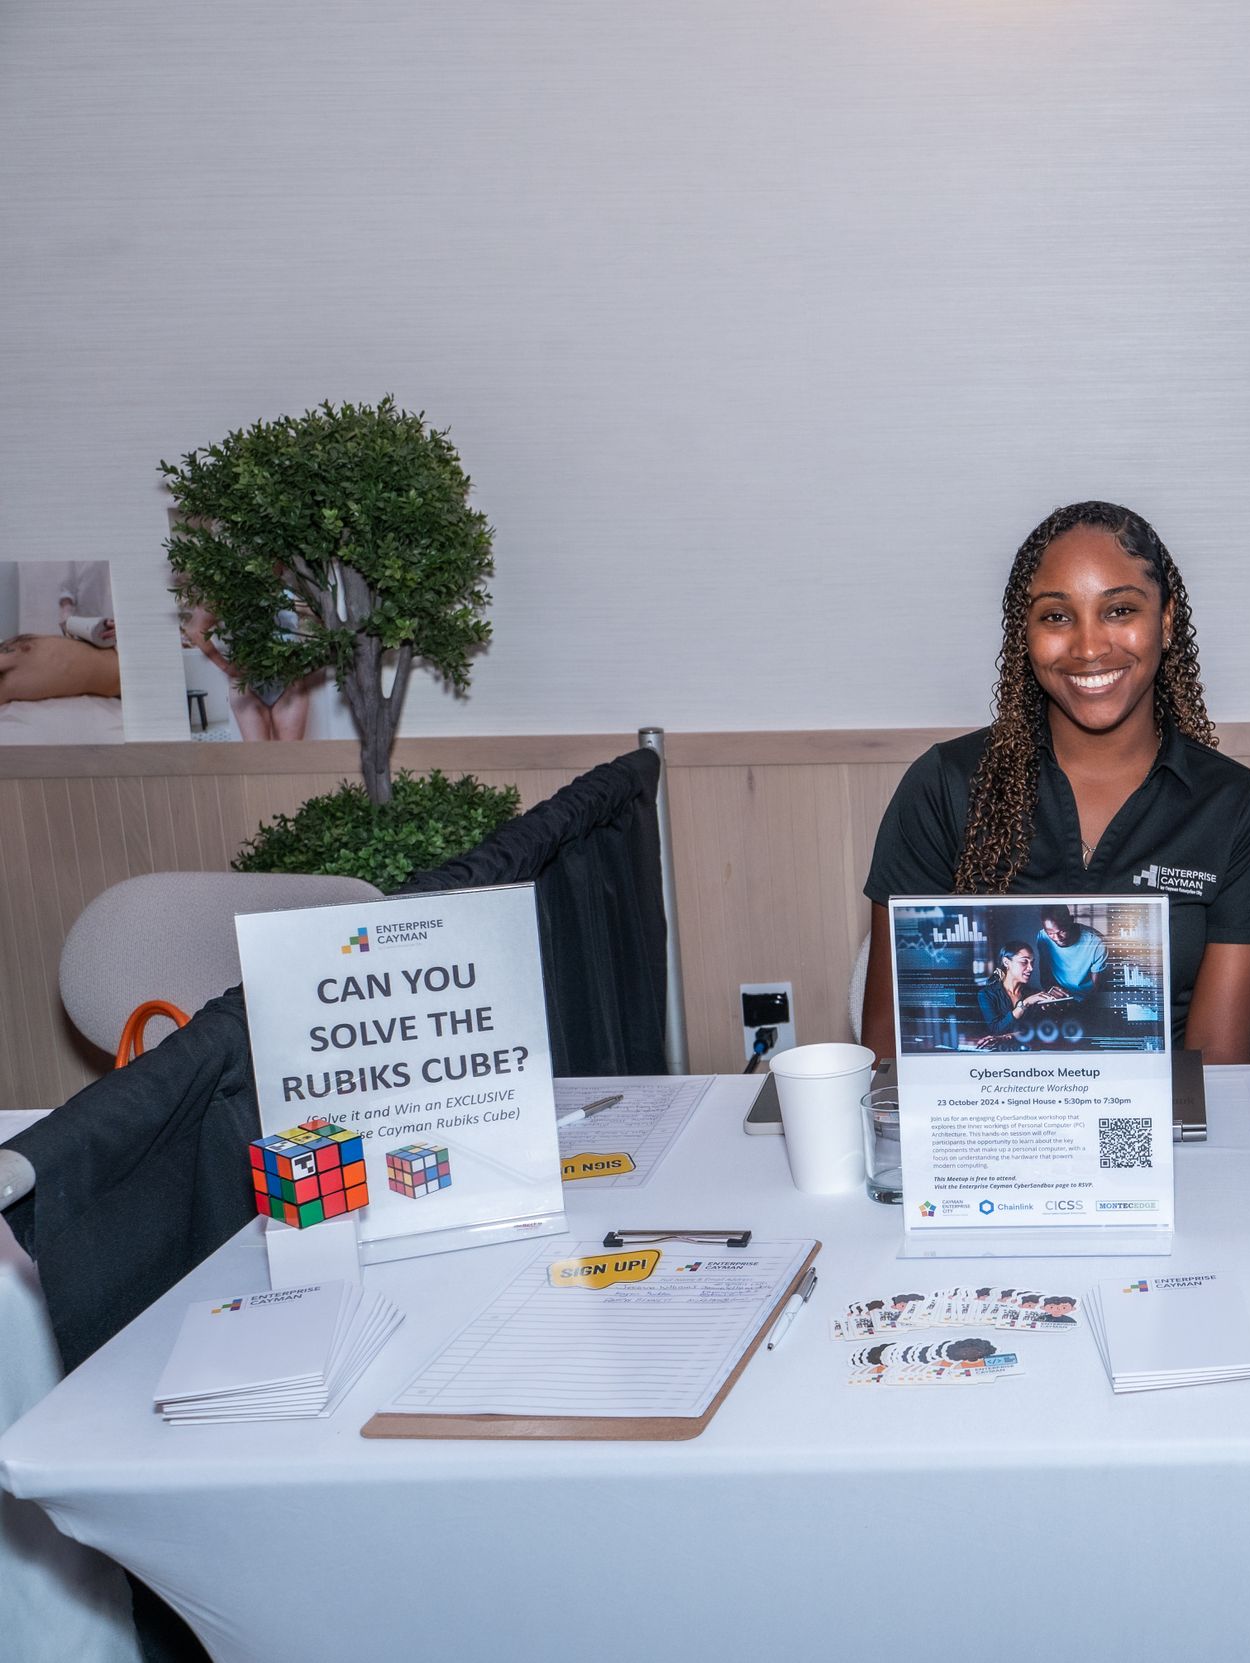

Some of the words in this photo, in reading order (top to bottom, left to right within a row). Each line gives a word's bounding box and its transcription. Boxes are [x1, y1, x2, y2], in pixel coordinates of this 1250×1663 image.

[1161, 867, 1216, 882] ENTERPRISE
[1160, 877, 1203, 890] CAYMAN
[376, 919, 444, 934] ENTERPRISE
[377, 932, 428, 944] CAYMAN
[316, 972, 392, 1004] CAN
[401, 963, 476, 994] YOU
[309, 1016, 418, 1052] SOLVE
[428, 1006, 494, 1037] THE
[282, 1062, 411, 1102] RUBIKS
[421, 1046, 529, 1084] CUBE?
[969, 1067, 1054, 1079] CyberSandbox
[1058, 1066, 1100, 1078] Meetup
[981, 1084, 992, 1092] PC
[994, 1084, 1044, 1093] Architecture
[1046, 1084, 1088, 1093] Workshop
[352, 1110, 360, 1121] it
[364, 1105, 390, 1118] and
[396, 1102, 421, 1116] Win
[425, 1100, 442, 1111] an
[446, 1090, 515, 1109] EXCLUSIVE
[1007, 1098, 1030, 1106] Signal
[1064, 1098, 1092, 1106] 5:30pm
[1104, 1097, 1132, 1106] 7:30pm
[378, 1121, 432, 1138] Cayman
[436, 1114, 479, 1129] Rubiks
[483, 1107, 520, 1123] Cube)
[582, 1160, 622, 1172] SIGN
[998, 1203, 1034, 1211] Chainlink
[1045, 1200, 1084, 1210] CICSS
[560, 1264, 607, 1279] SIGN
[614, 1259, 647, 1273] UP!
[1154, 1275, 1216, 1283] ENTERPRISE
[251, 1286, 321, 1300] ENTERPRISE
[250, 1294, 302, 1306] CAYMAN
